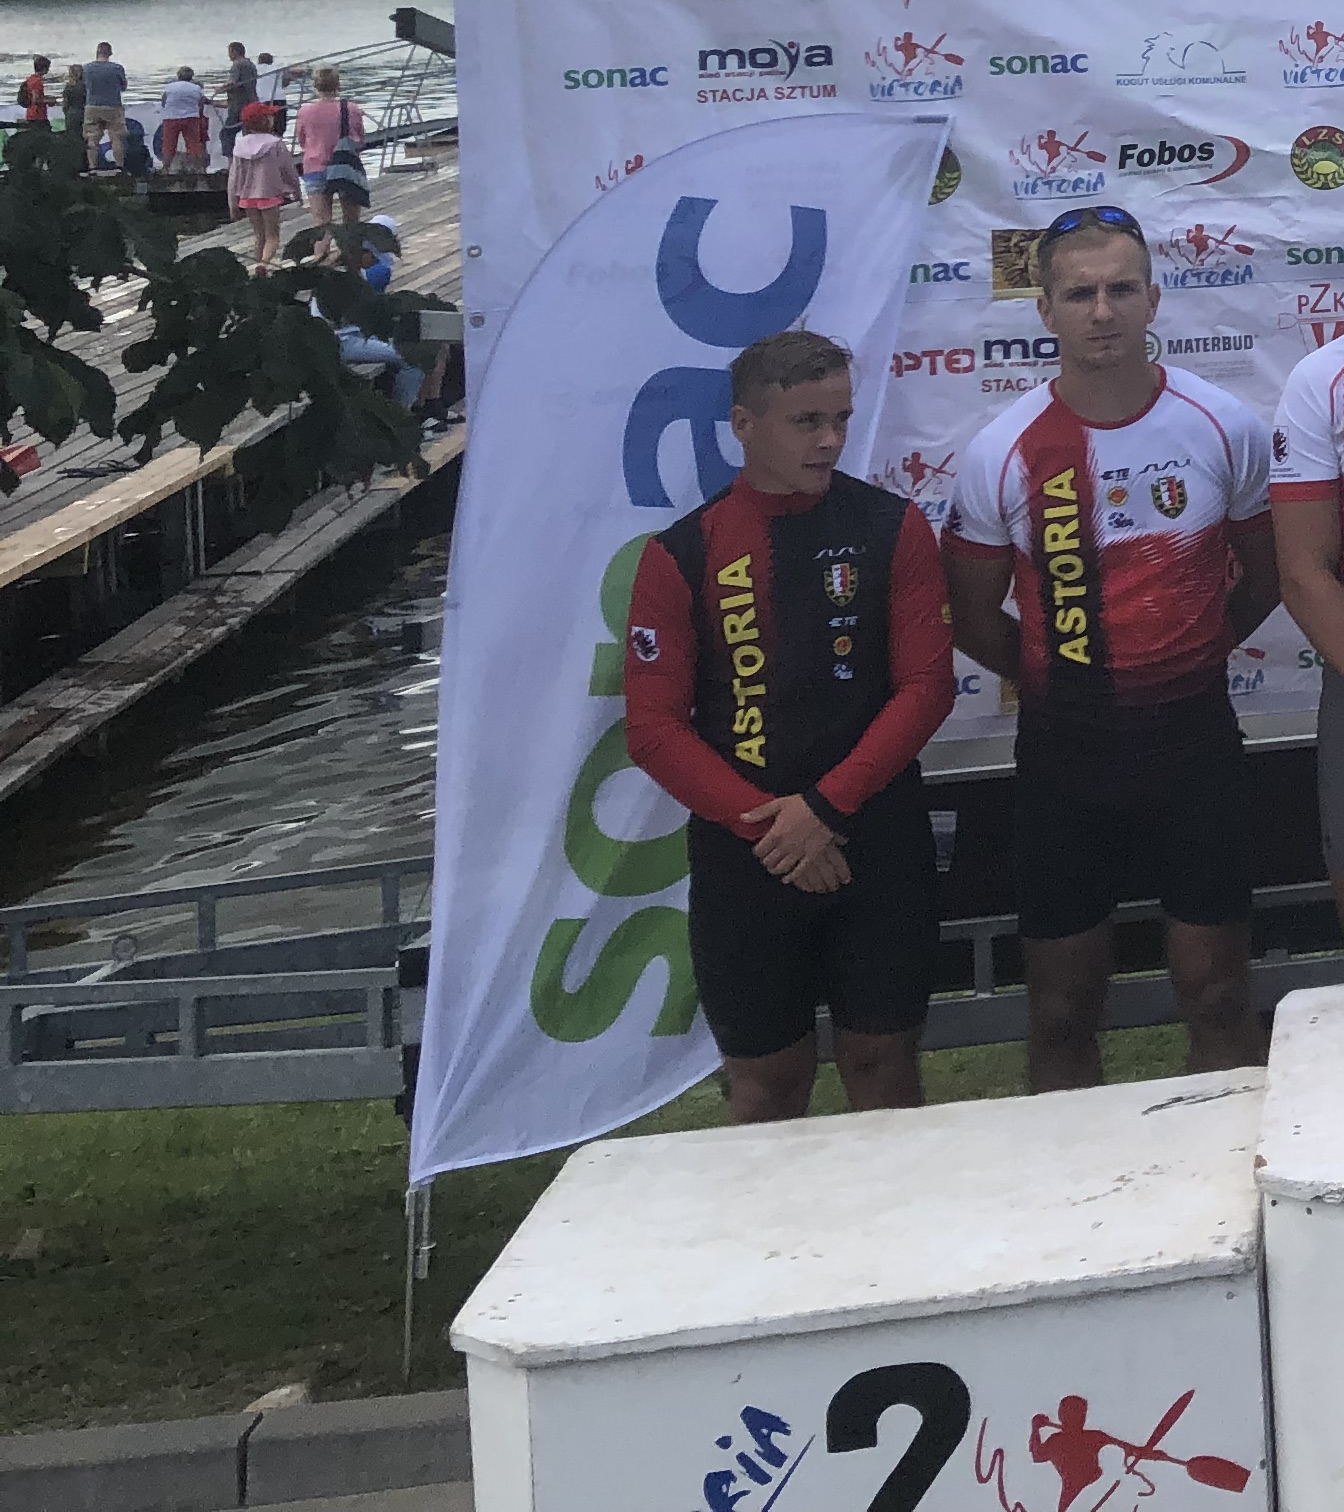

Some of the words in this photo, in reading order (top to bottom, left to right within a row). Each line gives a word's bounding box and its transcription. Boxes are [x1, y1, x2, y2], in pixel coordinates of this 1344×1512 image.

[698, 38, 833, 81] moya
[988, 52, 1089, 76] sonac
[563, 66, 669, 90] sonac
[696, 87, 769, 104] STACJA
[774, 84, 838, 101] SZTUM
[1302, 127, 1344, 147] LZS
[1118, 141, 1215, 170] Fobos
[910, 261, 972, 283] nac
[983, 337, 1060, 361] mo
[1167, 334, 1254, 355] MATERBUD
[1043, 466, 1092, 665] ASTORIA
[718, 553, 767, 768] ASTORIA
[826, 1362, 971, 1512] 2
